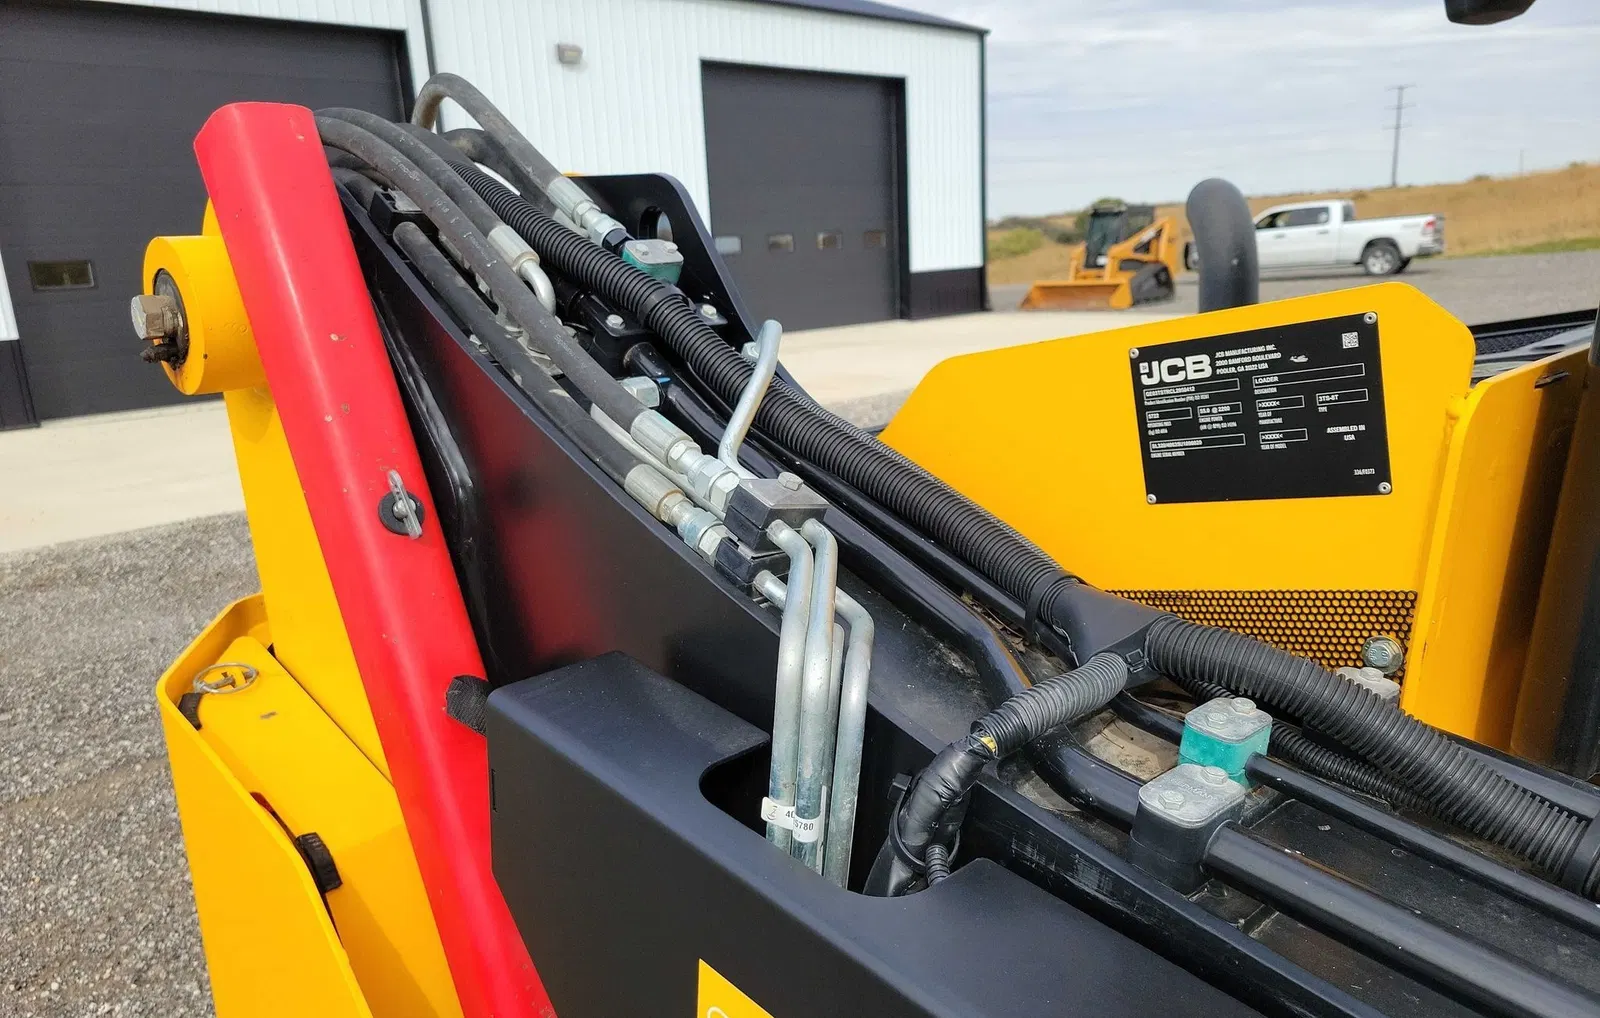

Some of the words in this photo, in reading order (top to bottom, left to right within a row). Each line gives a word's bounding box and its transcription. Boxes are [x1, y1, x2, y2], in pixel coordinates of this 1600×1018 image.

[1224, 345, 1265, 356] MANUFACTURING
[1266, 343, 1276, 351] INC.
[1228, 356, 1252, 364] BAMFORD
[1252, 352, 1281, 362] BOULEVARD
[1139, 354, 1212, 385] JCB
[1216, 366, 1236, 374] POOLER,
[1255, 375, 1279, 384] LOADER
